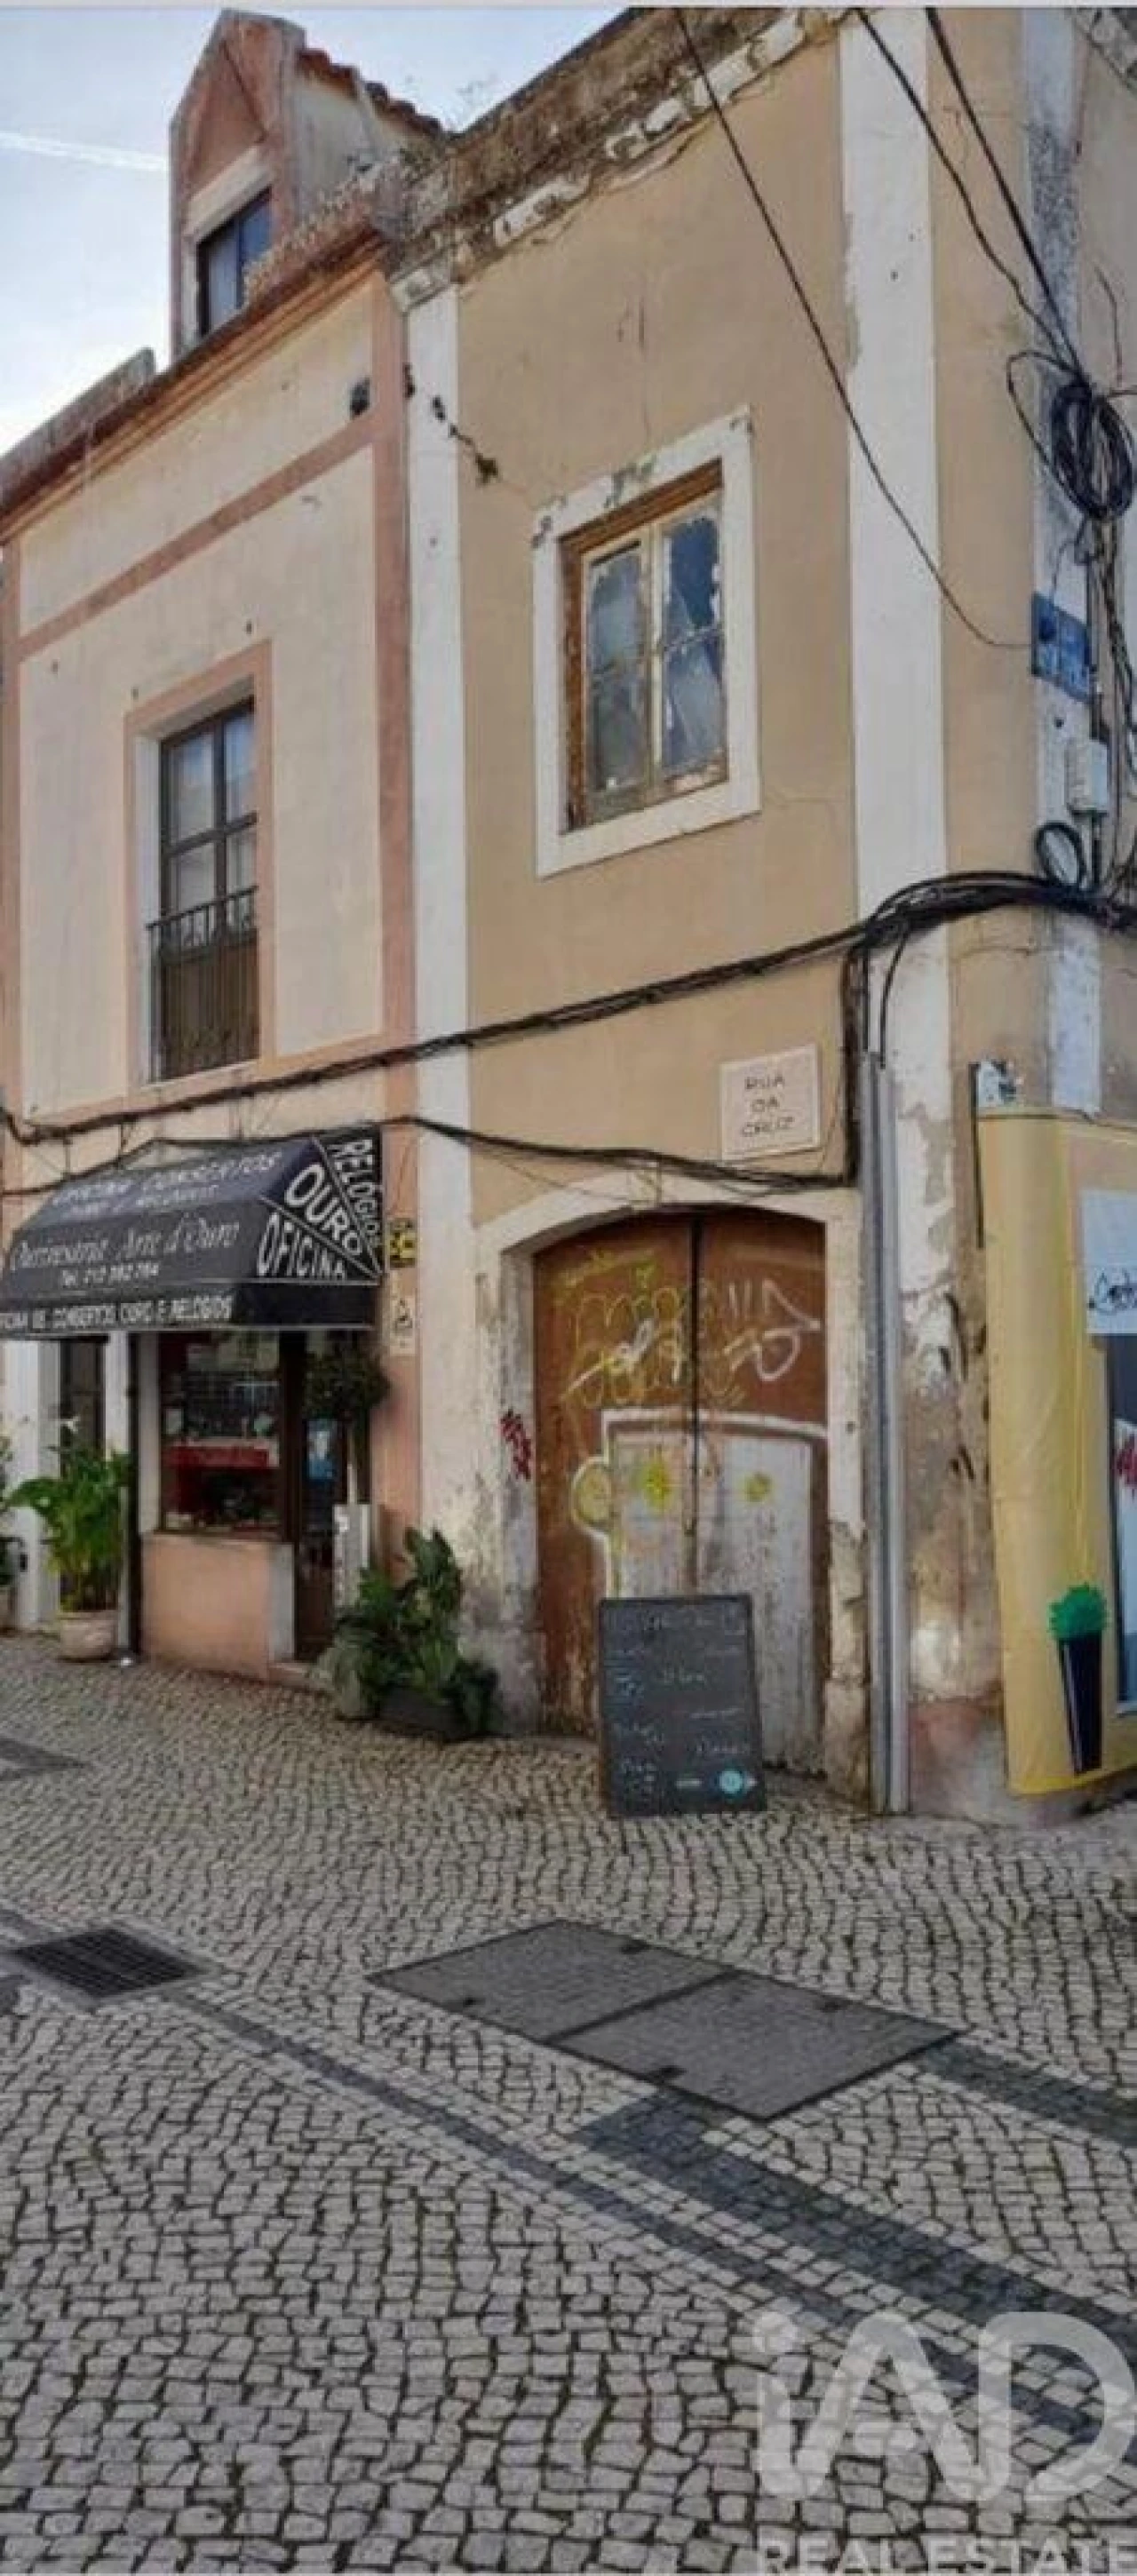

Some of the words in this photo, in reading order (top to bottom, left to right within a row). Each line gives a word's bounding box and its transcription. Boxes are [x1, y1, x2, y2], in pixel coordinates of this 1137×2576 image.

[744, 1073, 785, 1090] RUA
[751, 1096, 780, 1113] DA
[741, 1116, 795, 1138] CRUZ
[284, 1164, 362, 1256] OURO
[256, 1212, 347, 1280] OFICINA
